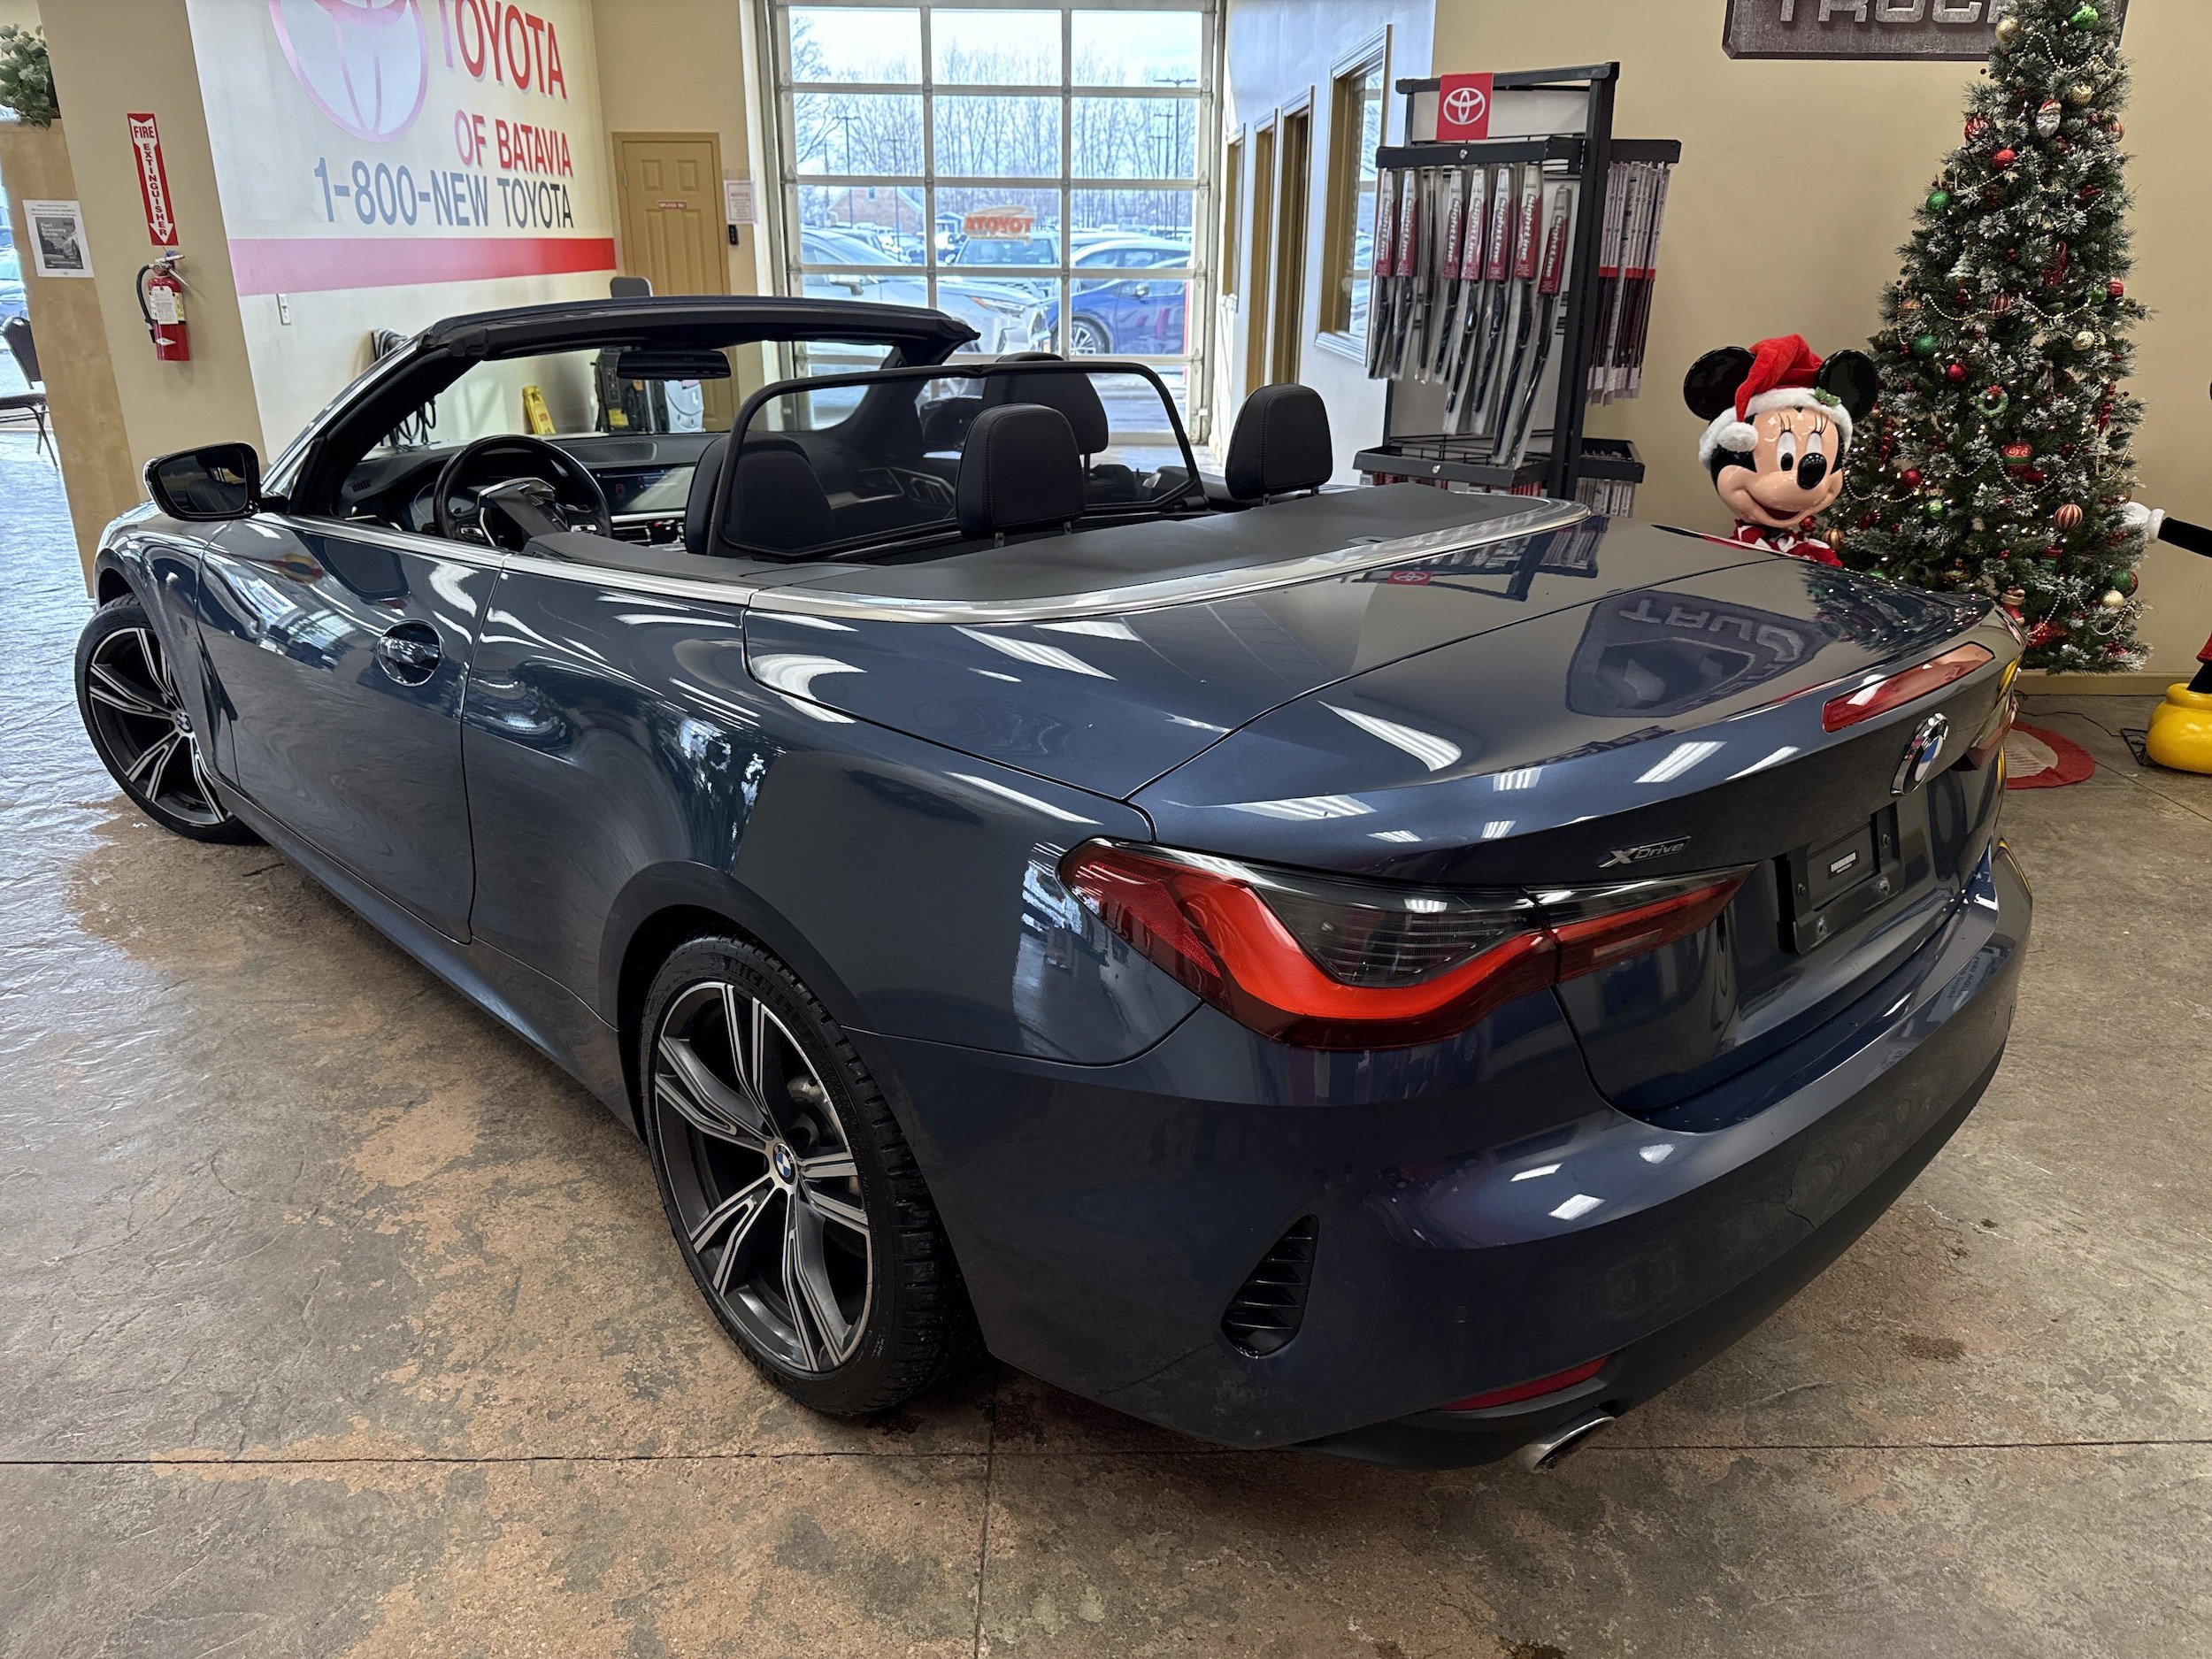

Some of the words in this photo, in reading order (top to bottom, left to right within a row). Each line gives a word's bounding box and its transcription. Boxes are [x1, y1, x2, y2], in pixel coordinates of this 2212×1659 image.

[439, 0, 568, 101] TOYOTA
[134, 126, 155, 139] FIRE
[454, 109, 487, 167] OF
[495, 119, 574, 178] BATAVIA
[142, 143, 167, 237] EXTINGUISHER
[313, 157, 489, 227] 1-800-NEW
[496, 177, 574, 229] TOYOTA
